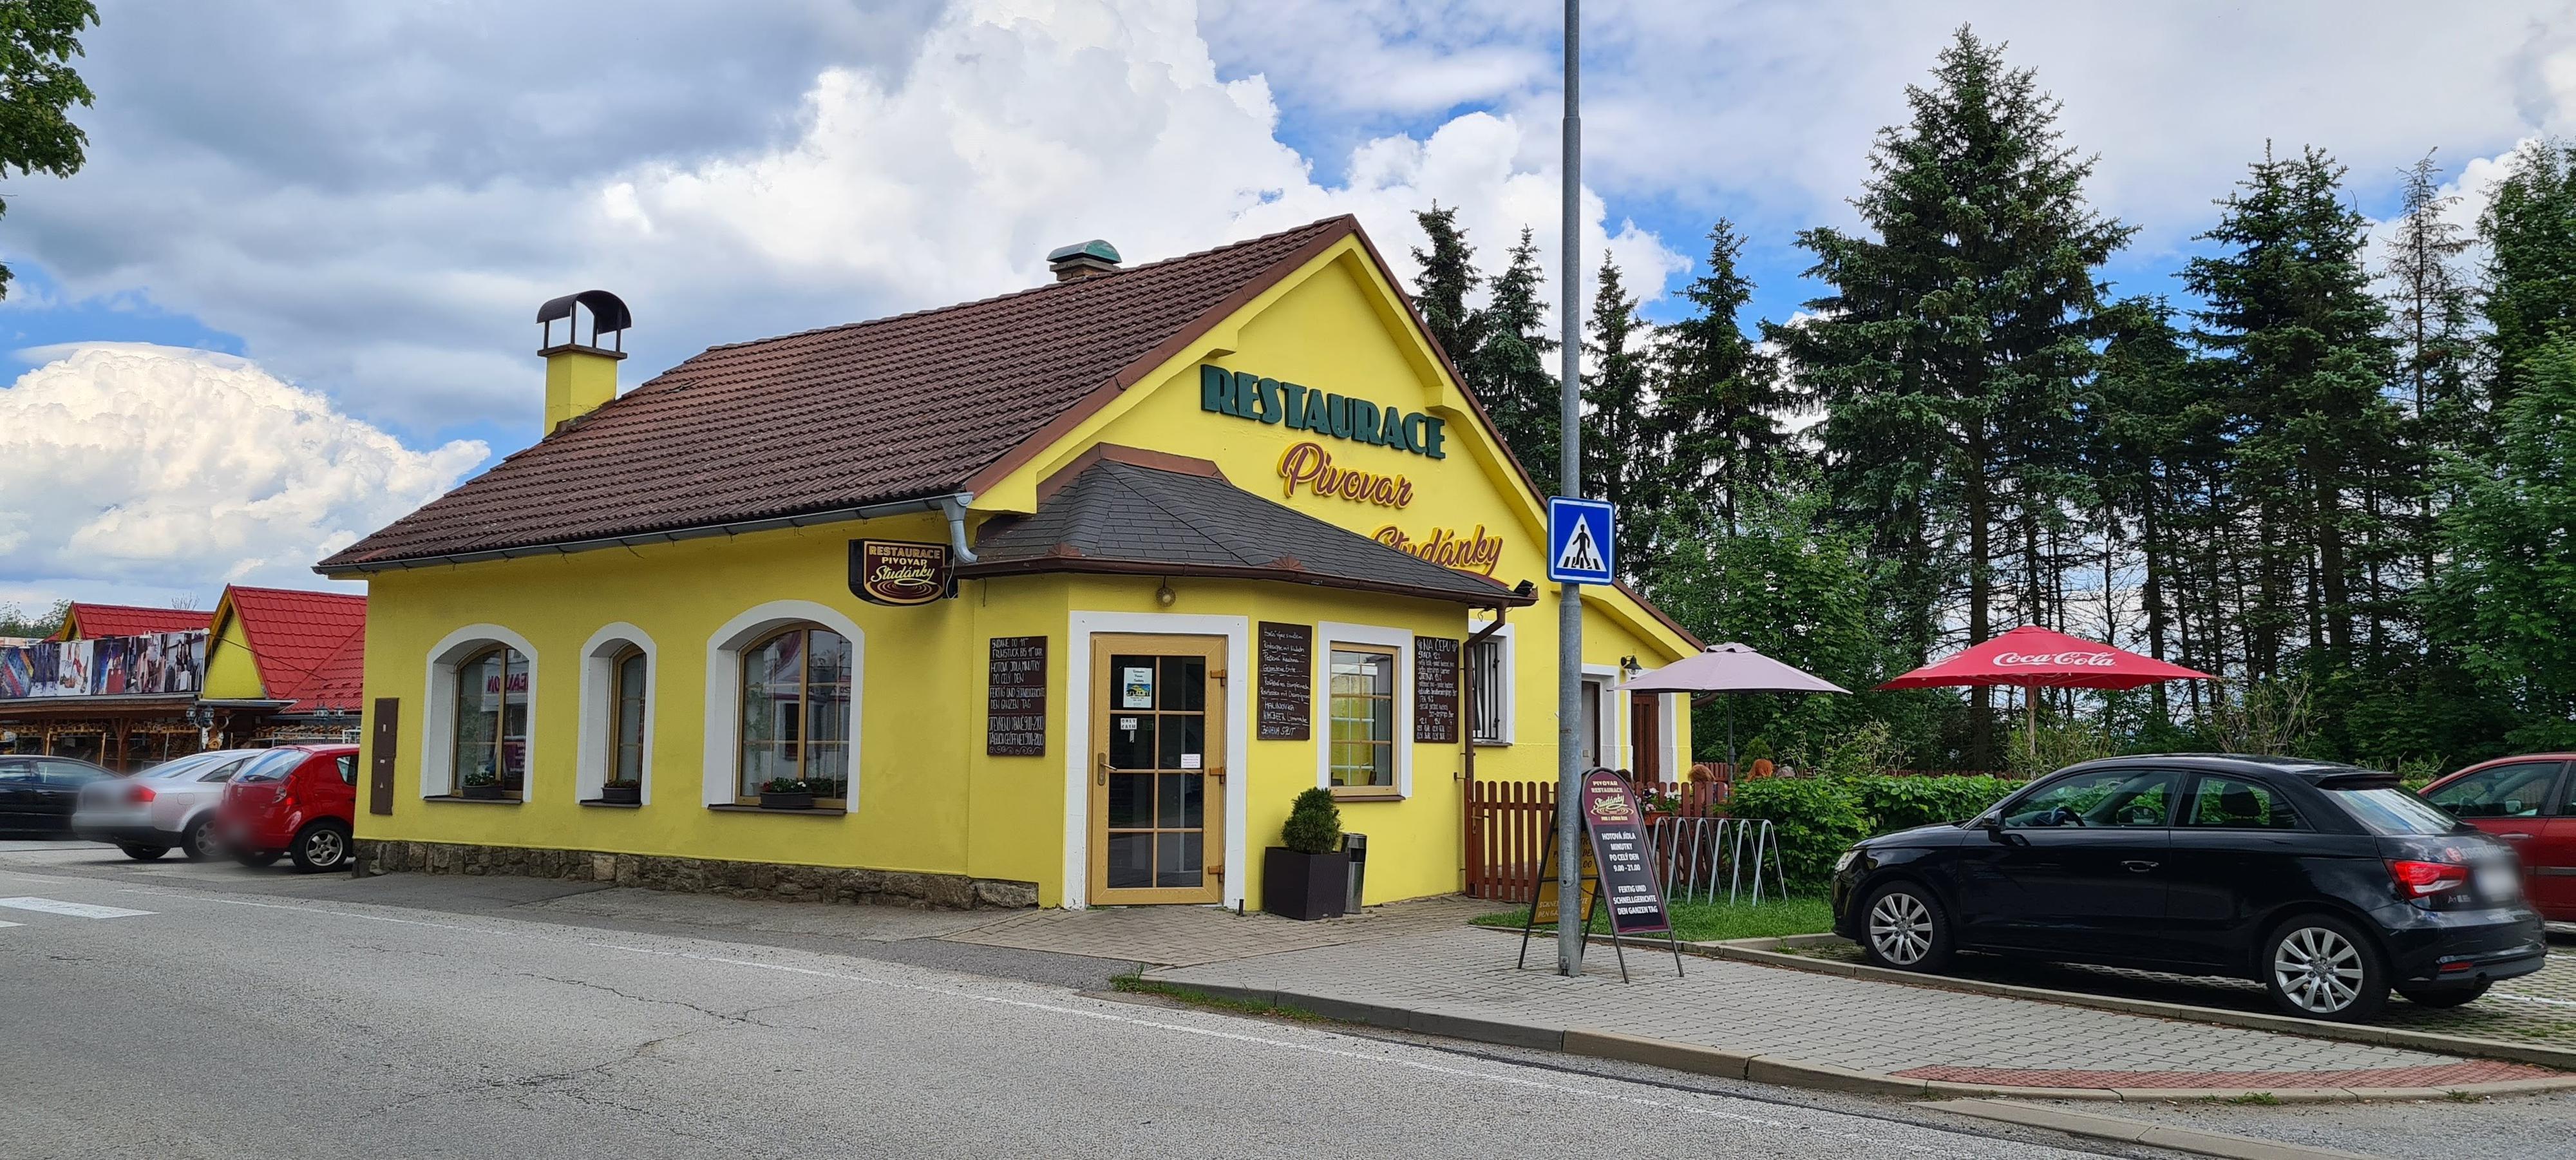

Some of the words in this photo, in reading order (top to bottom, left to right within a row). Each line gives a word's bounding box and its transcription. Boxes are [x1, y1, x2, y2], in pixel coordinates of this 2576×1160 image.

[1201, 364, 1446, 460] RESTAURACE
[1278, 441, 1413, 509] Pivovar
[869, 546, 940, 559] RESTAURACE
[882, 556, 927, 566] PIVOVAR
[870, 566, 938, 586] Studánky
[1423, 638, 1434, 651] NA
[1435, 638, 1452, 652] ČEPU
[1993, 652, 2116, 666] Coca-Cola
[1014, 672, 1025, 683] DEN
[1021, 699, 1031, 709] TAG
[1593, 793, 1628, 810] Studánky
[1602, 832, 1623, 840] HOTOVÁ
[1617, 852, 1629, 860] CELÝ
[1618, 885, 1635, 893] FERTIG
[1613, 895, 1657, 904] SCHNELLGERICHTE
[1628, 906, 1649, 915] GANZEN
